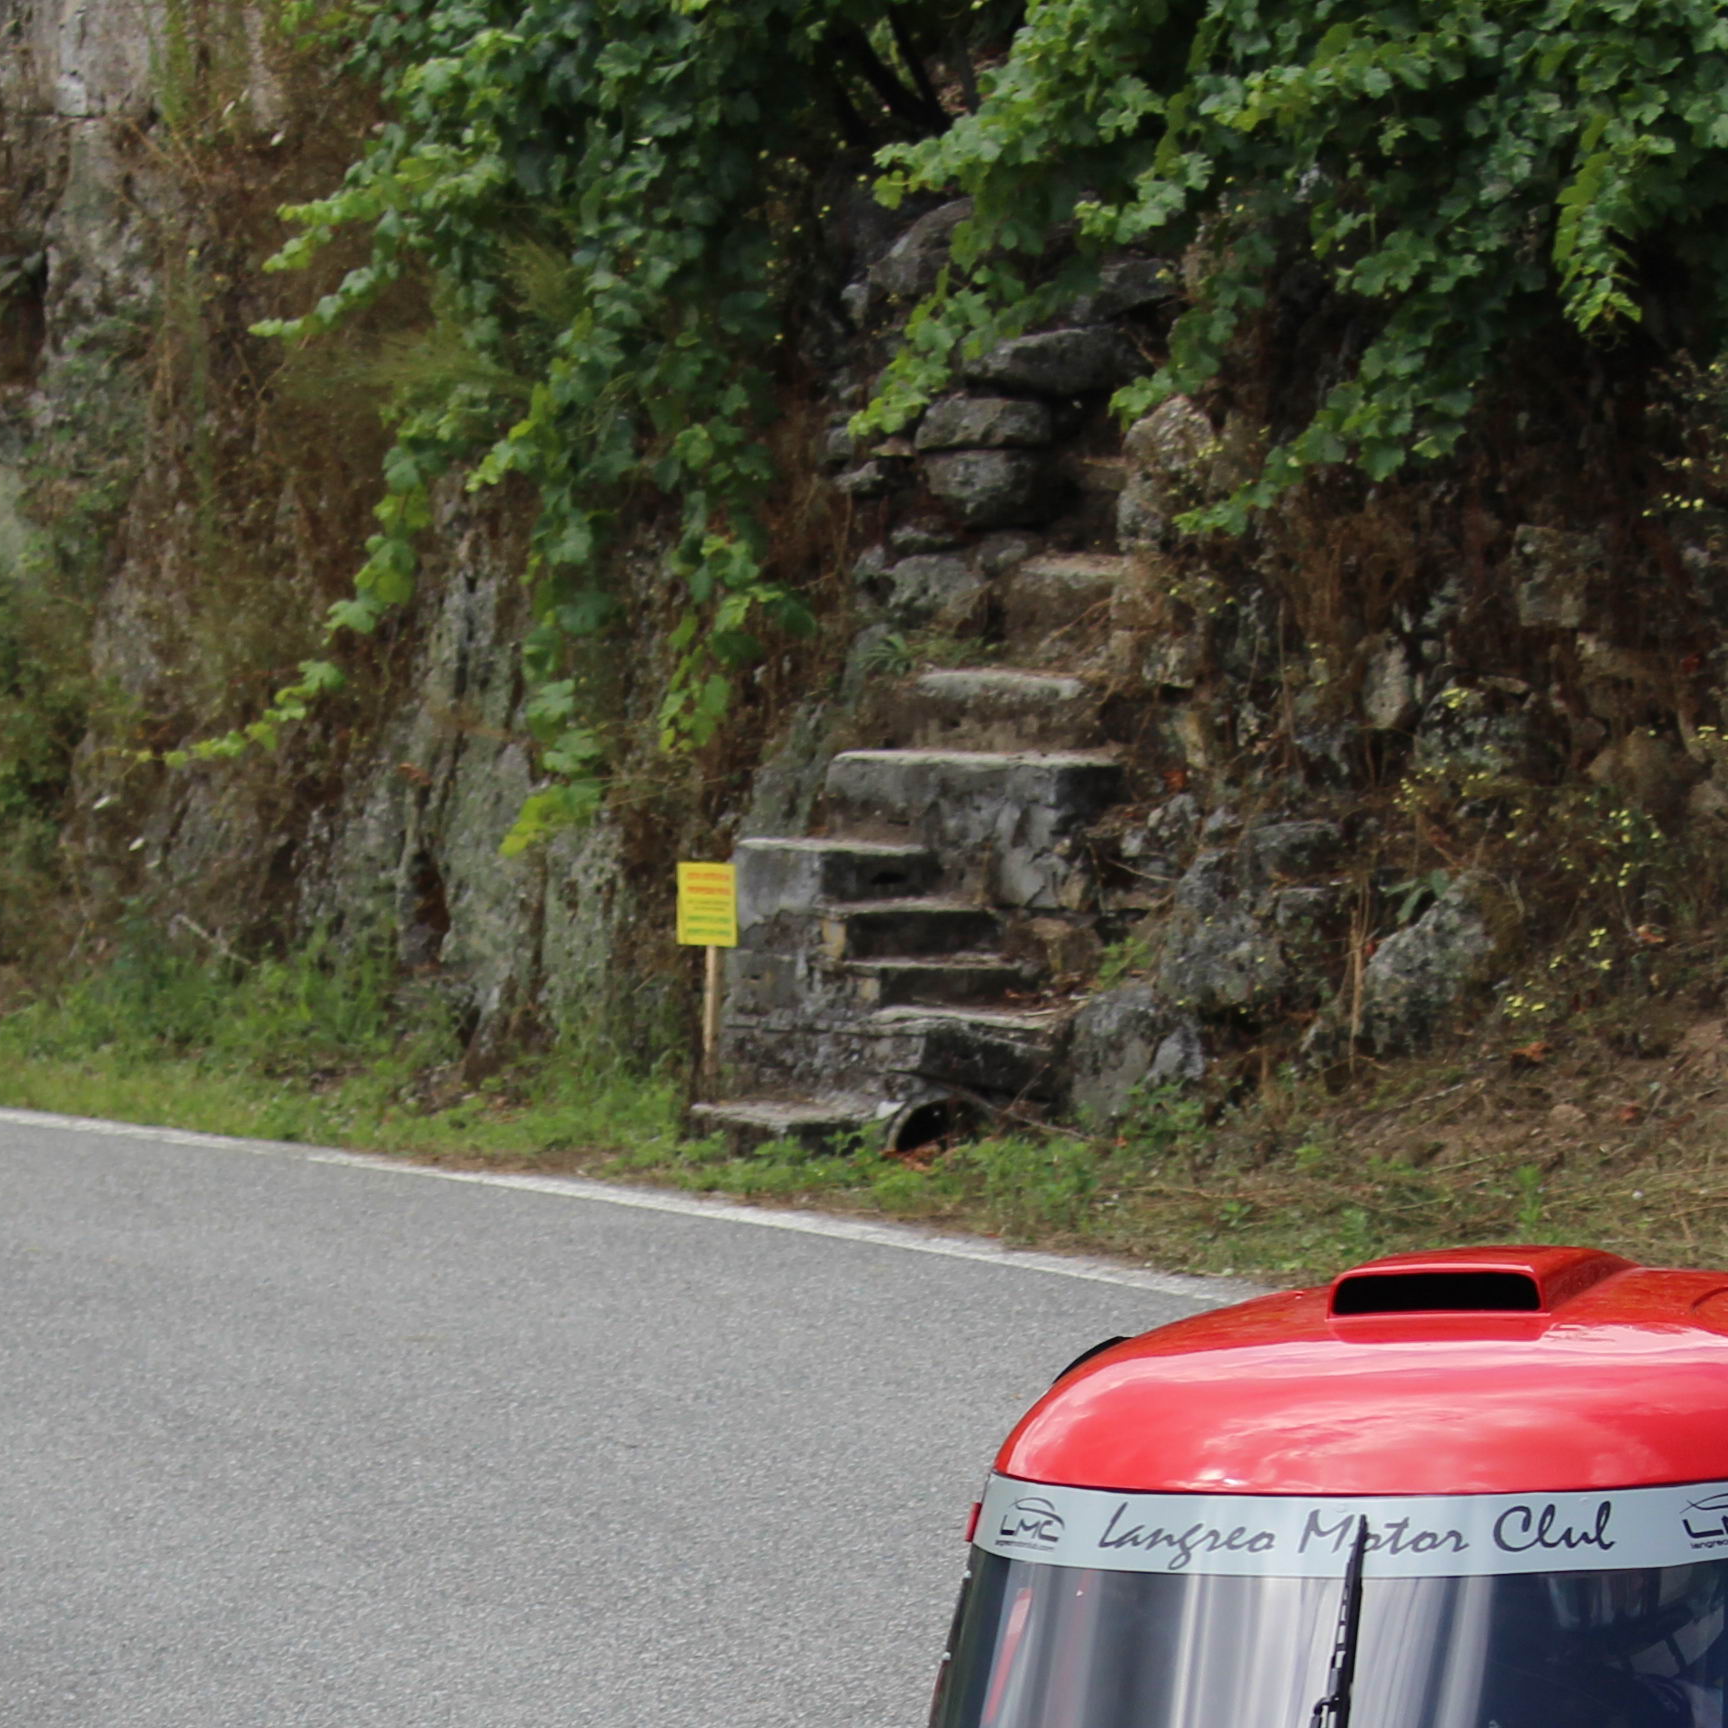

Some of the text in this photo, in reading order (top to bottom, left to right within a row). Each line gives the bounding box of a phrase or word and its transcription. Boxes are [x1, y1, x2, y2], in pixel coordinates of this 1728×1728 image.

[1000, 1514, 1060, 1543] LMC
[1098, 1501, 1276, 1571] Langreo
[1297, 1508, 1469, 1555] Motor
